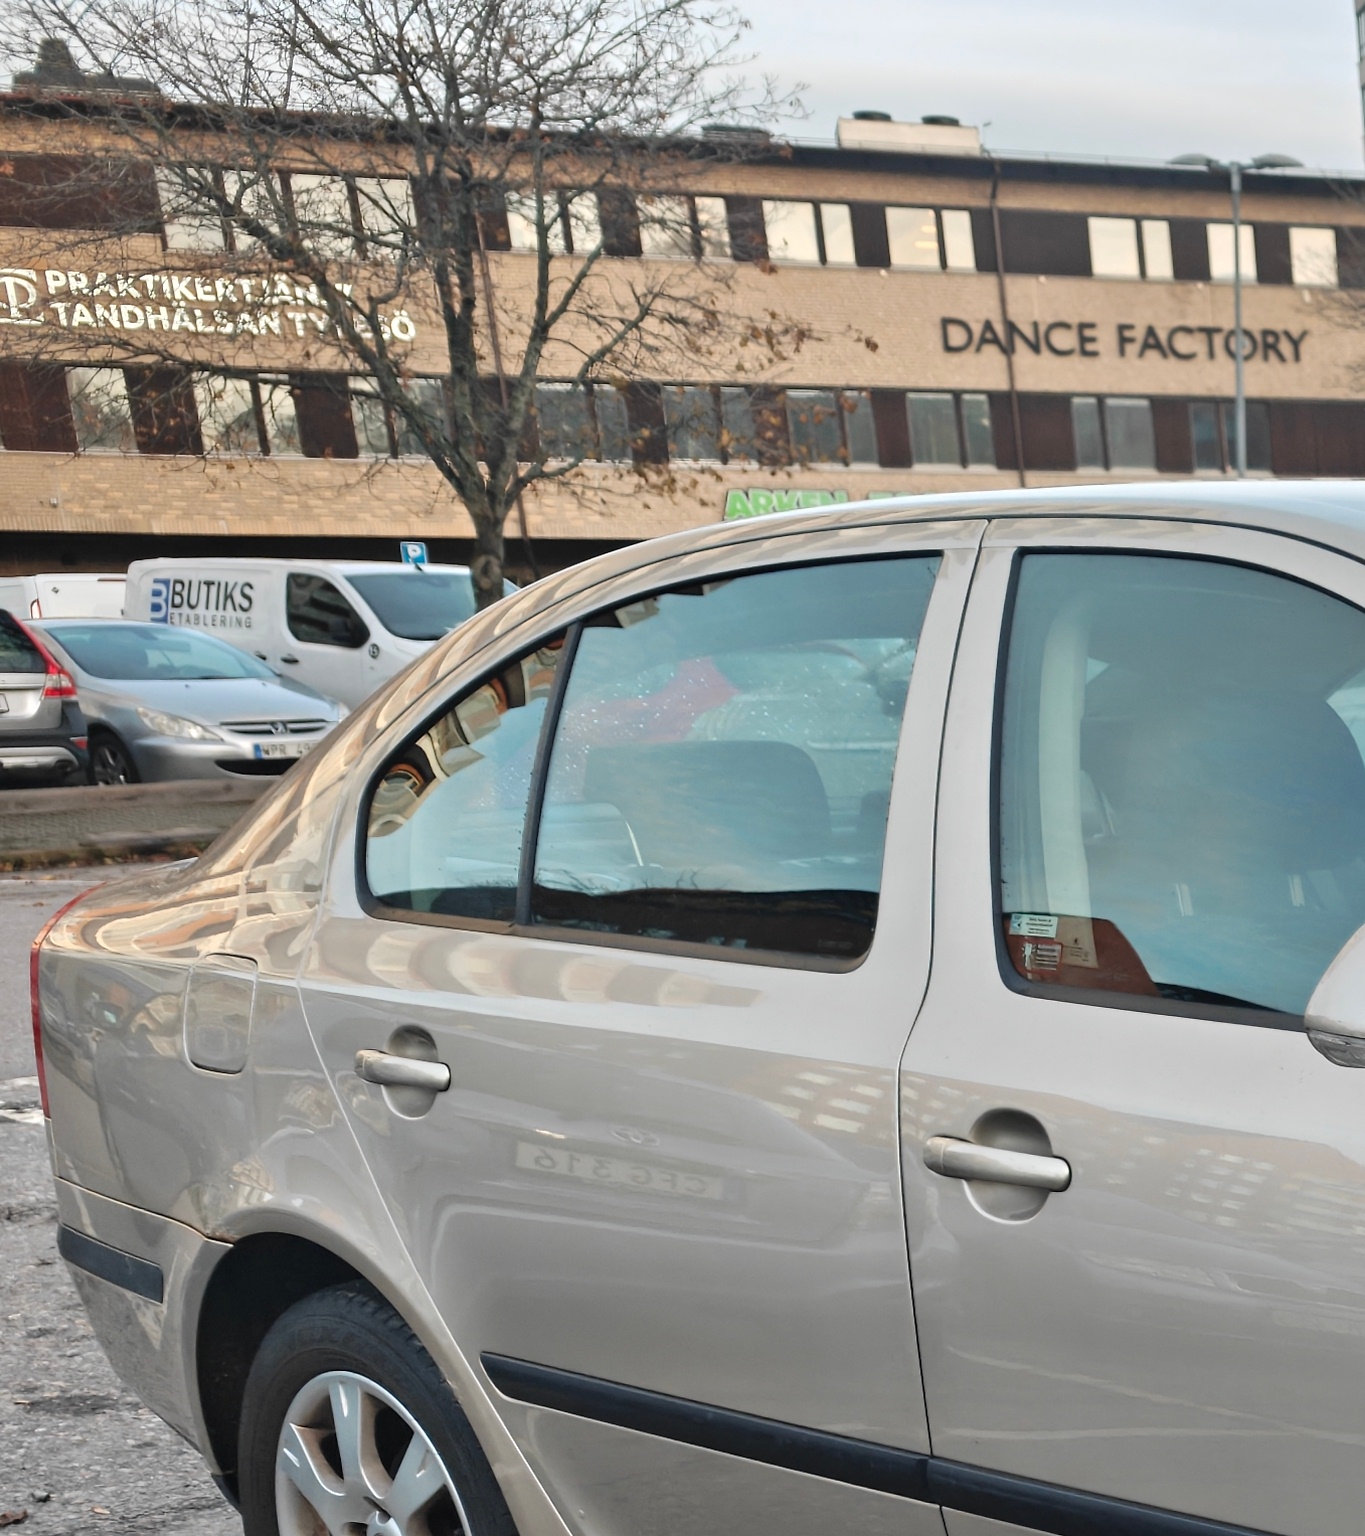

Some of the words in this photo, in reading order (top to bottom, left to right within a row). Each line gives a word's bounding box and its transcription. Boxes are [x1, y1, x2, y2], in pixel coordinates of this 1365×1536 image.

[49, 300, 281, 336] TANDHÄLSAN
[287, 309, 416, 342] TYESÖ
[941, 317, 1099, 357] DANCE
[1116, 323, 1309, 363] FACTORY
[171, 579, 254, 612] BUTIKS
[169, 612, 252, 628] ETABLERING
